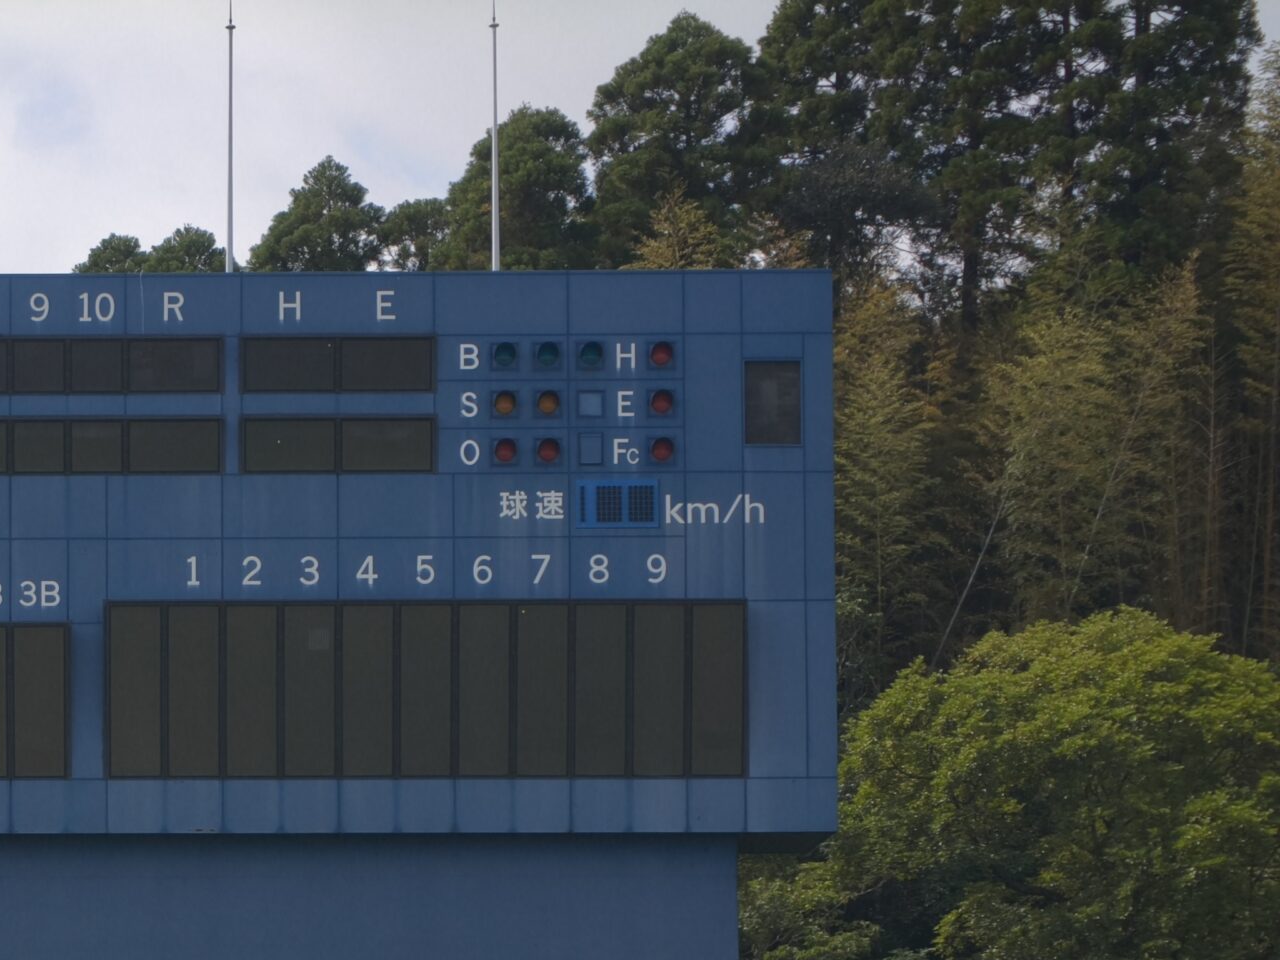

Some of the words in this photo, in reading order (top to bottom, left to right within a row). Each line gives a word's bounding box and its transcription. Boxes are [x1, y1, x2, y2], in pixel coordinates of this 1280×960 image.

[30, 293, 49, 322] 9
[79, 292, 115, 322] 10
[163, 292, 184, 321] R
[279, 291, 301, 321] H
[376, 290, 396, 320] E
[459, 343, 480, 370] B
[616, 343, 636, 369] H
[460, 391, 478, 418] S
[617, 390, 635, 417] E
[499, 490, 564, 520] 球速
[665, 494, 765, 524] km/h
[187, 556, 200, 586] 1
[242, 555, 262, 585] 2
[299, 556, 320, 585] 3
[356, 555, 378, 585] 4
[416, 555, 435, 585] 5
[473, 555, 493, 585] 6
[531, 554, 551, 584] 7
[589, 554, 609, 584] 8
[647, 554, 667, 583] 9
[19, 580, 60, 607] 3B
